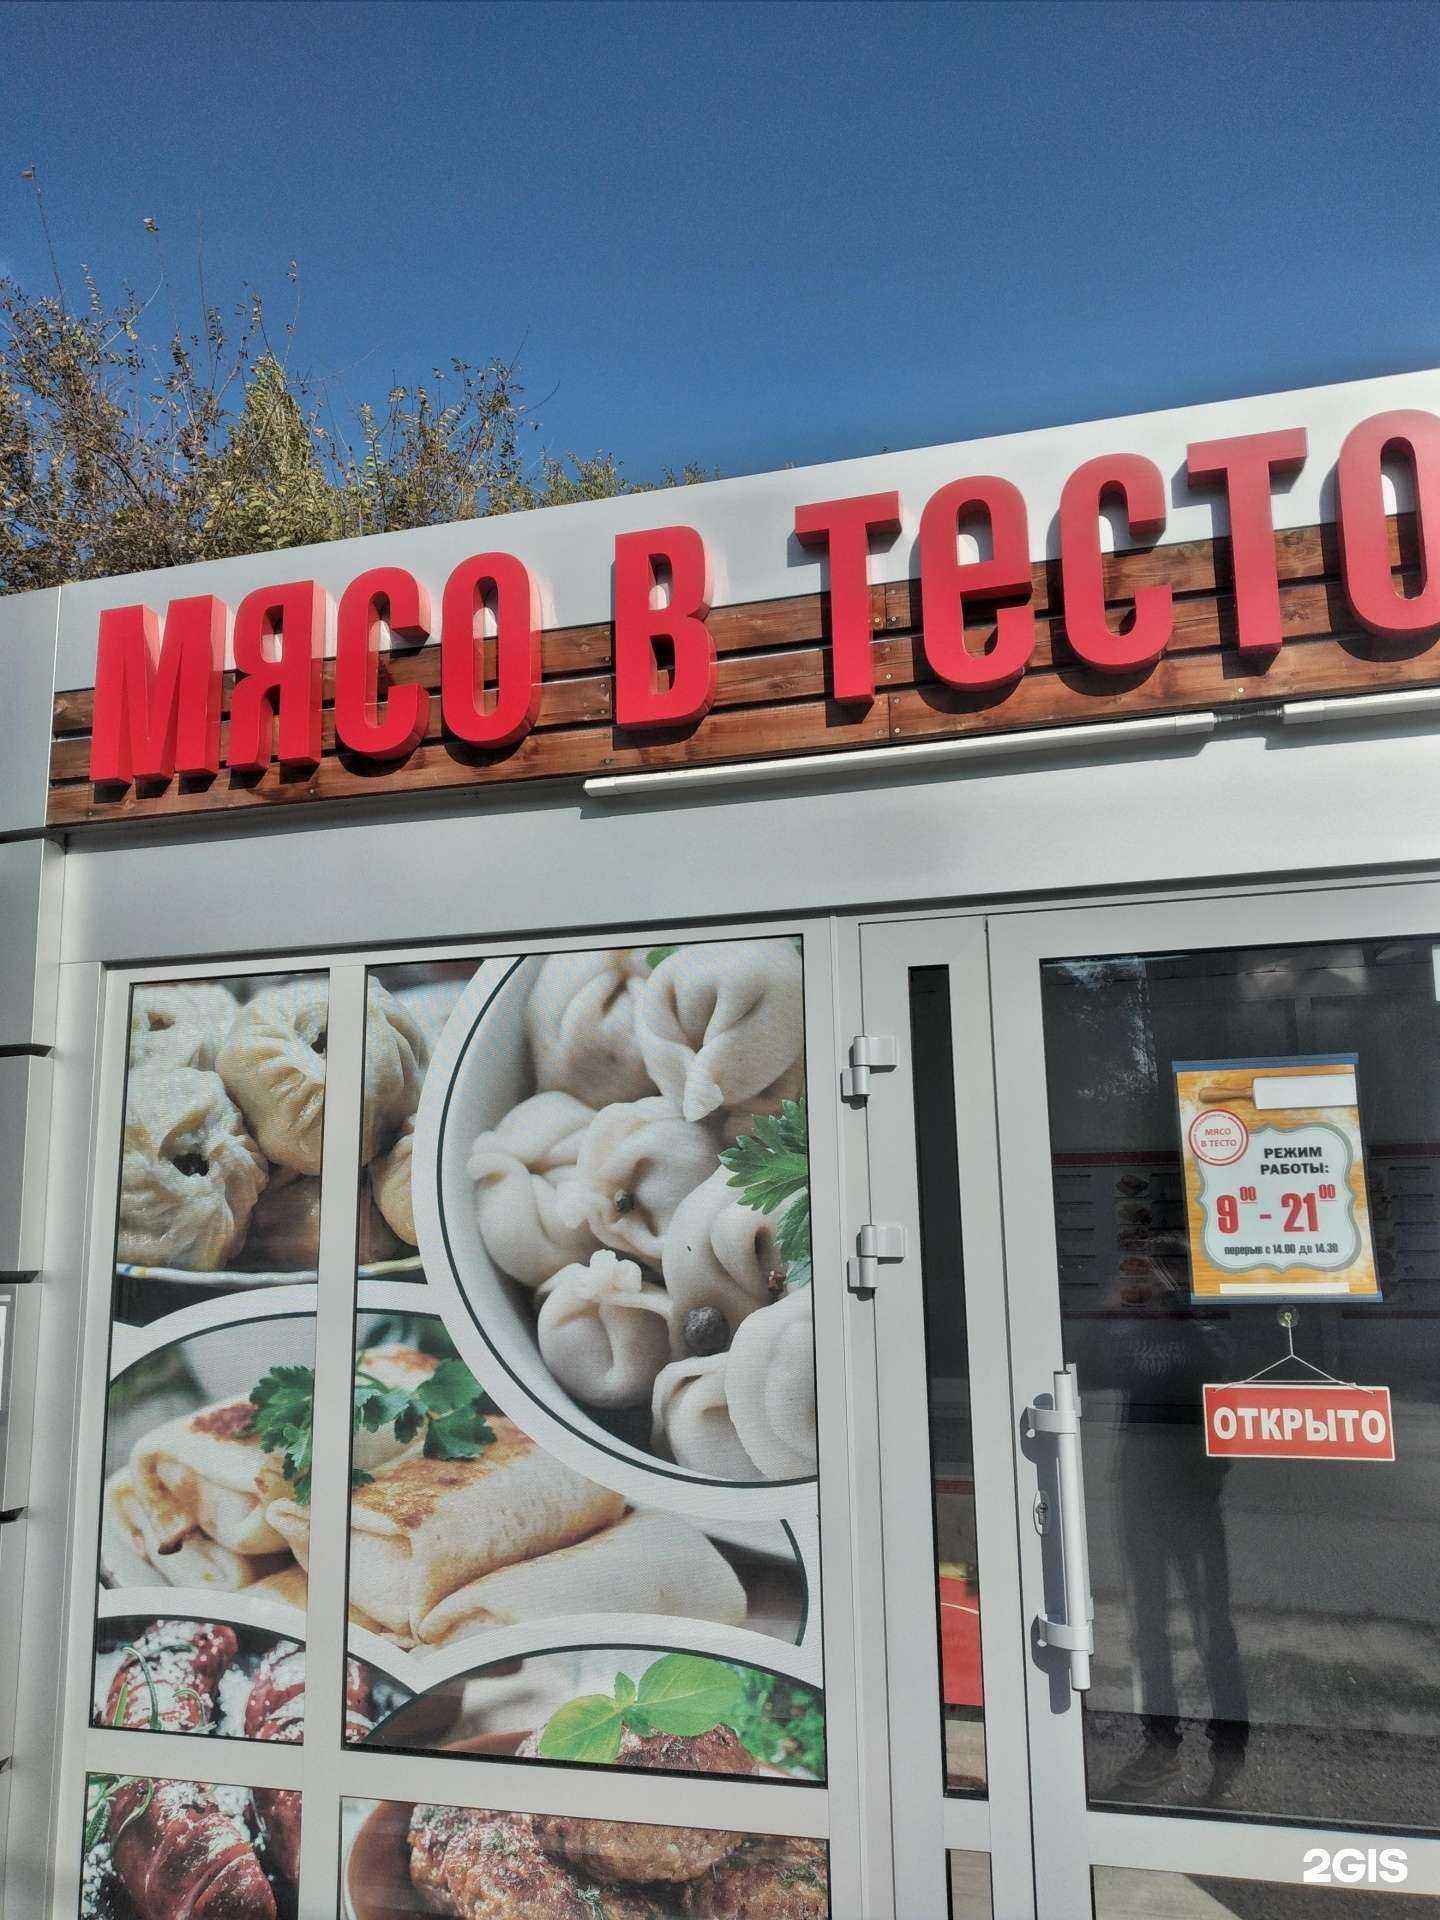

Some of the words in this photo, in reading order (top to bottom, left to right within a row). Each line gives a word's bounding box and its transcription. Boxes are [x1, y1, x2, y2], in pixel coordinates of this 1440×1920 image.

[90, 551, 540, 785] МЯСО
[615, 525, 718, 732] В
[1204, 1128, 1232, 1136] МЯСО
[1264, 1146, 1322, 1159] РЕЖИМ
[1260, 1163, 1329, 1175] РАБОТЫ:
[1224, 1245, 1263, 1256] перерыв
[1213, 1406, 1386, 1444] ОТКРЫТО
